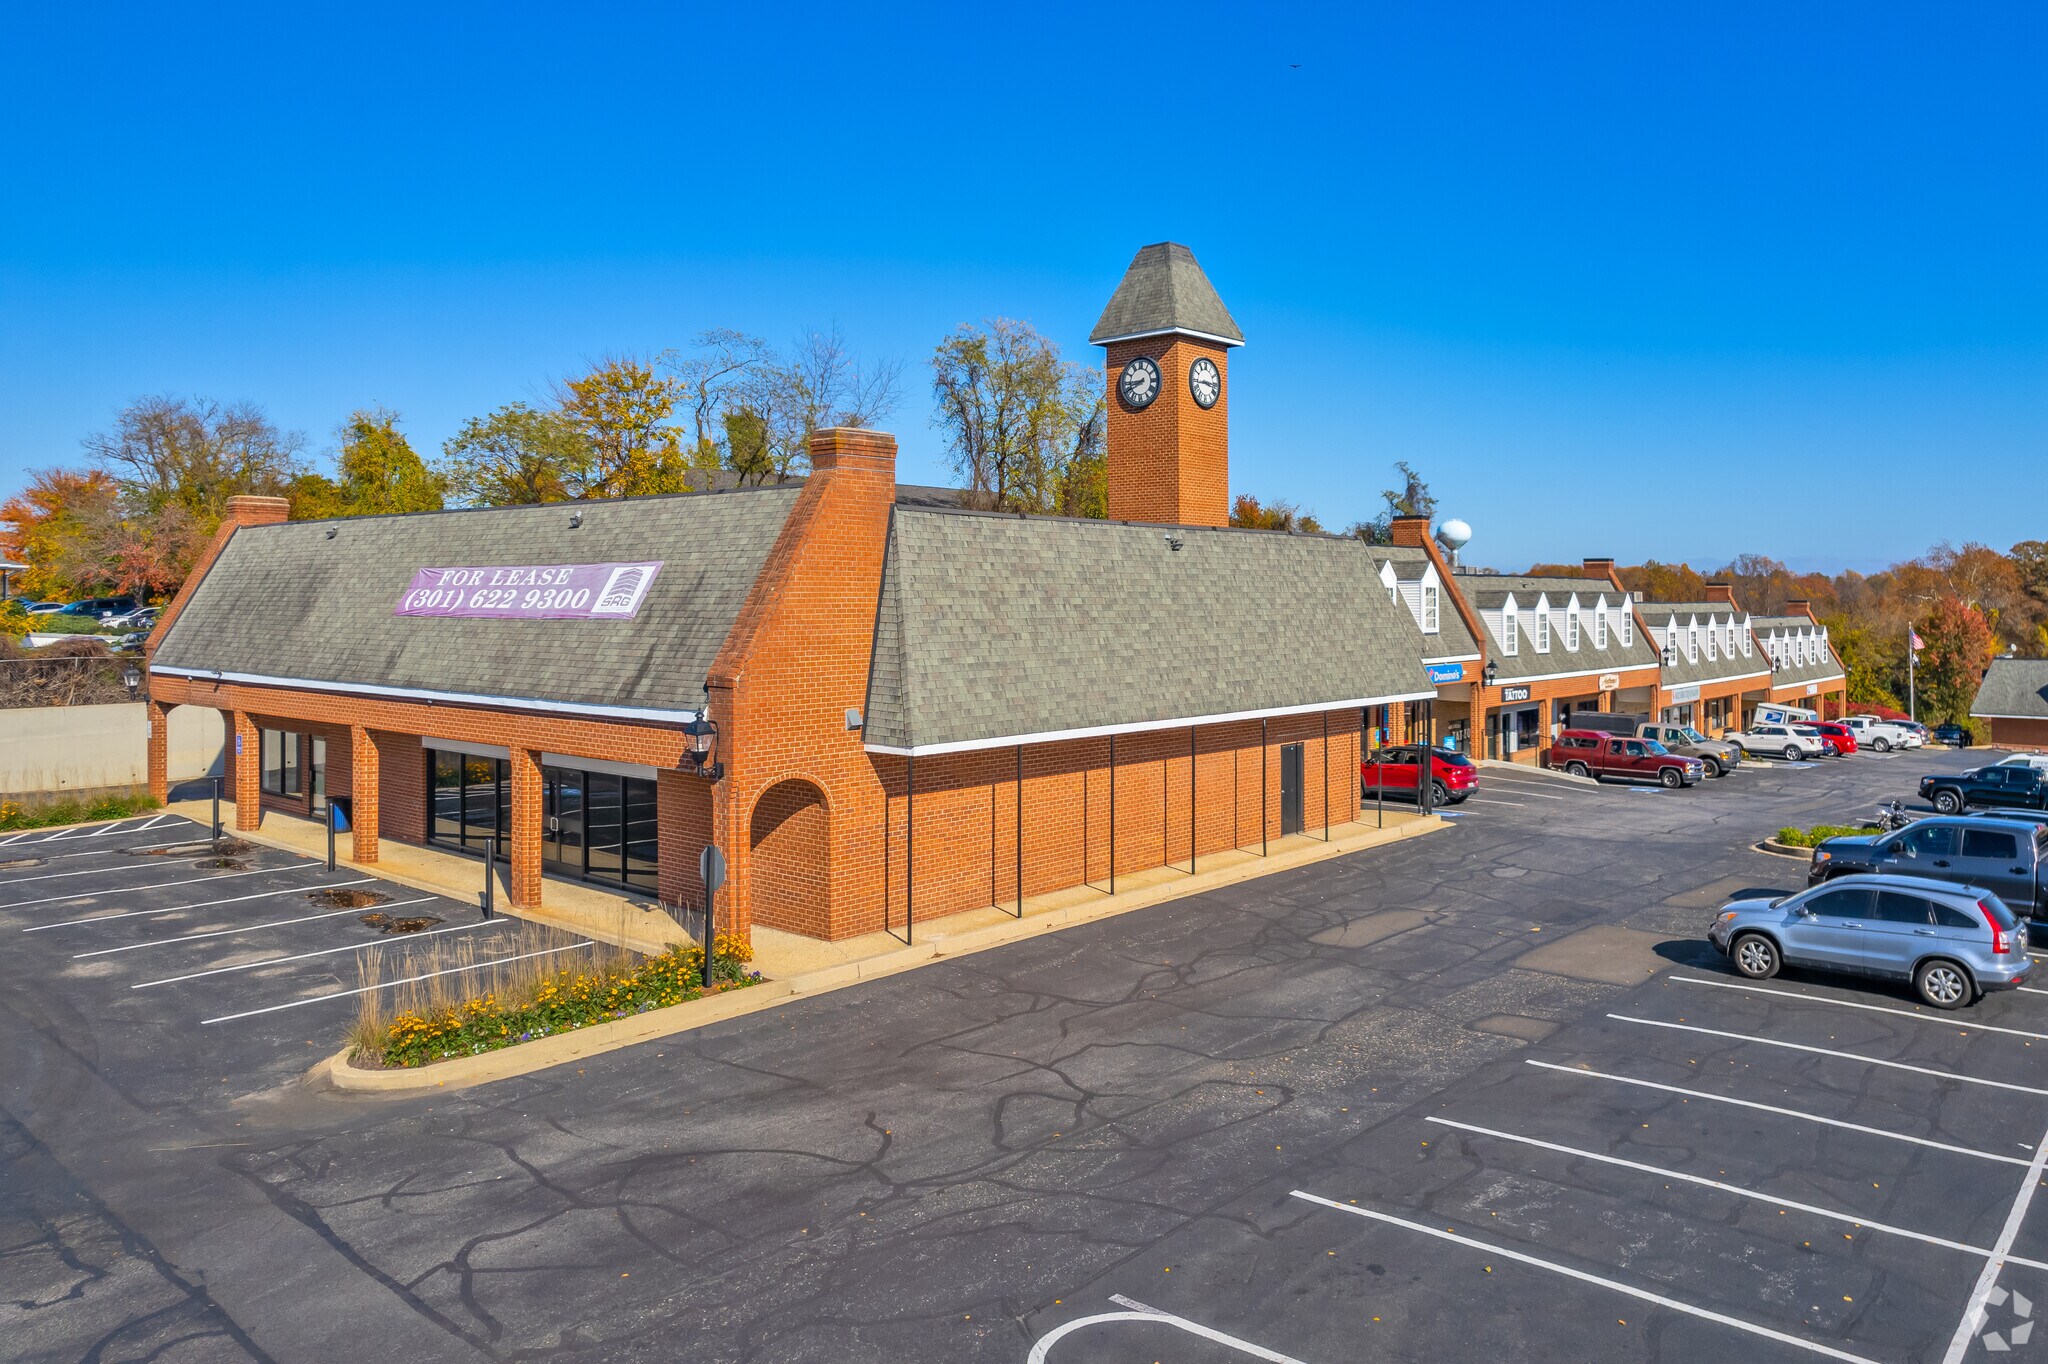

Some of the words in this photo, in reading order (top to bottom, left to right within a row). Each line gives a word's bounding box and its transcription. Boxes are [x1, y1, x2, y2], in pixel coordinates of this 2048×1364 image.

[437, 570, 485, 586] FOR
[488, 568, 574, 586] LEASE
[404, 588, 465, 612] (301)
[469, 588, 518, 609] 622
[520, 588, 590, 609] 9300
[1434, 669, 1460, 681] Domino's
[1504, 689, 1528, 701] TATTOO
